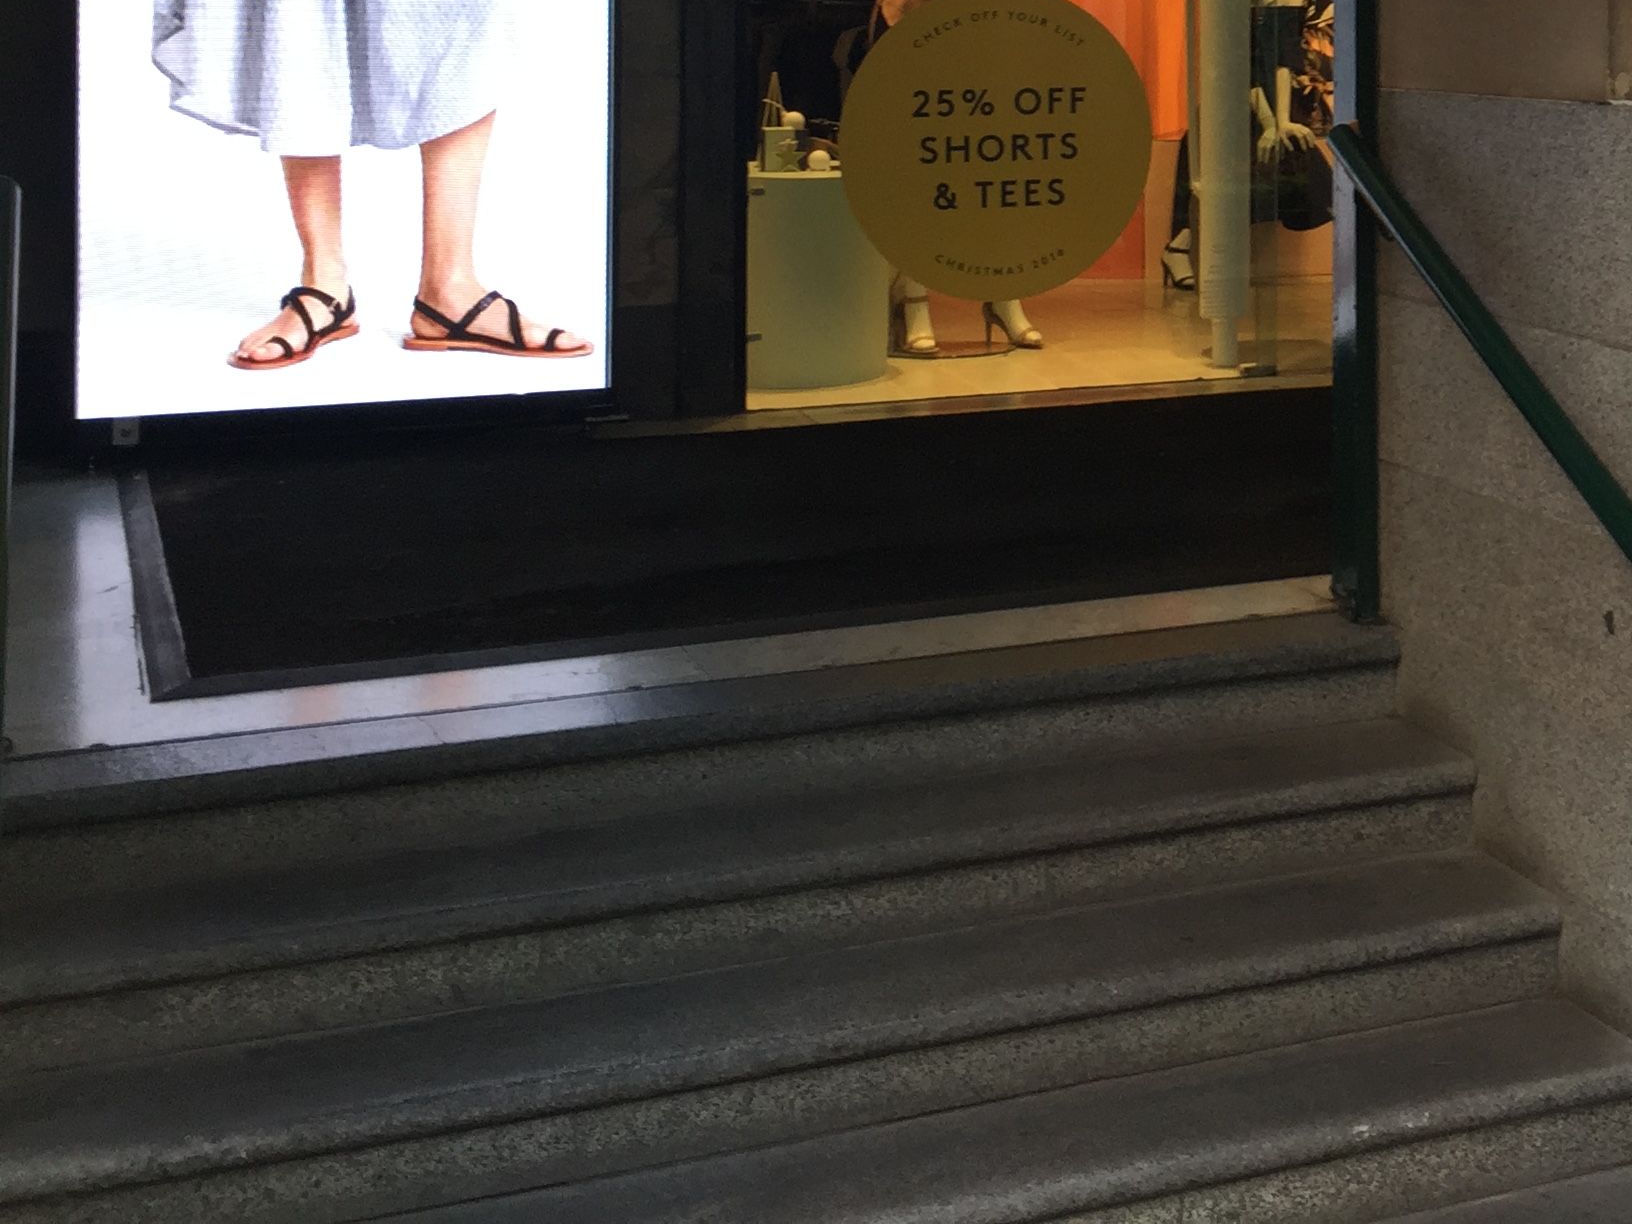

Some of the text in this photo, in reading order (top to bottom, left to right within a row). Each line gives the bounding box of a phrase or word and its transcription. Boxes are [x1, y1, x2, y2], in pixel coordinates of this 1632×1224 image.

[912, 10, 1086, 49] CHECK OFF YOUR LIST
[911, 86, 1087, 118] 25% OFF
[919, 132, 1080, 165] SHORTS
[932, 178, 1066, 211] & TEES
[934, 253, 1026, 276] CHRISTMAS
